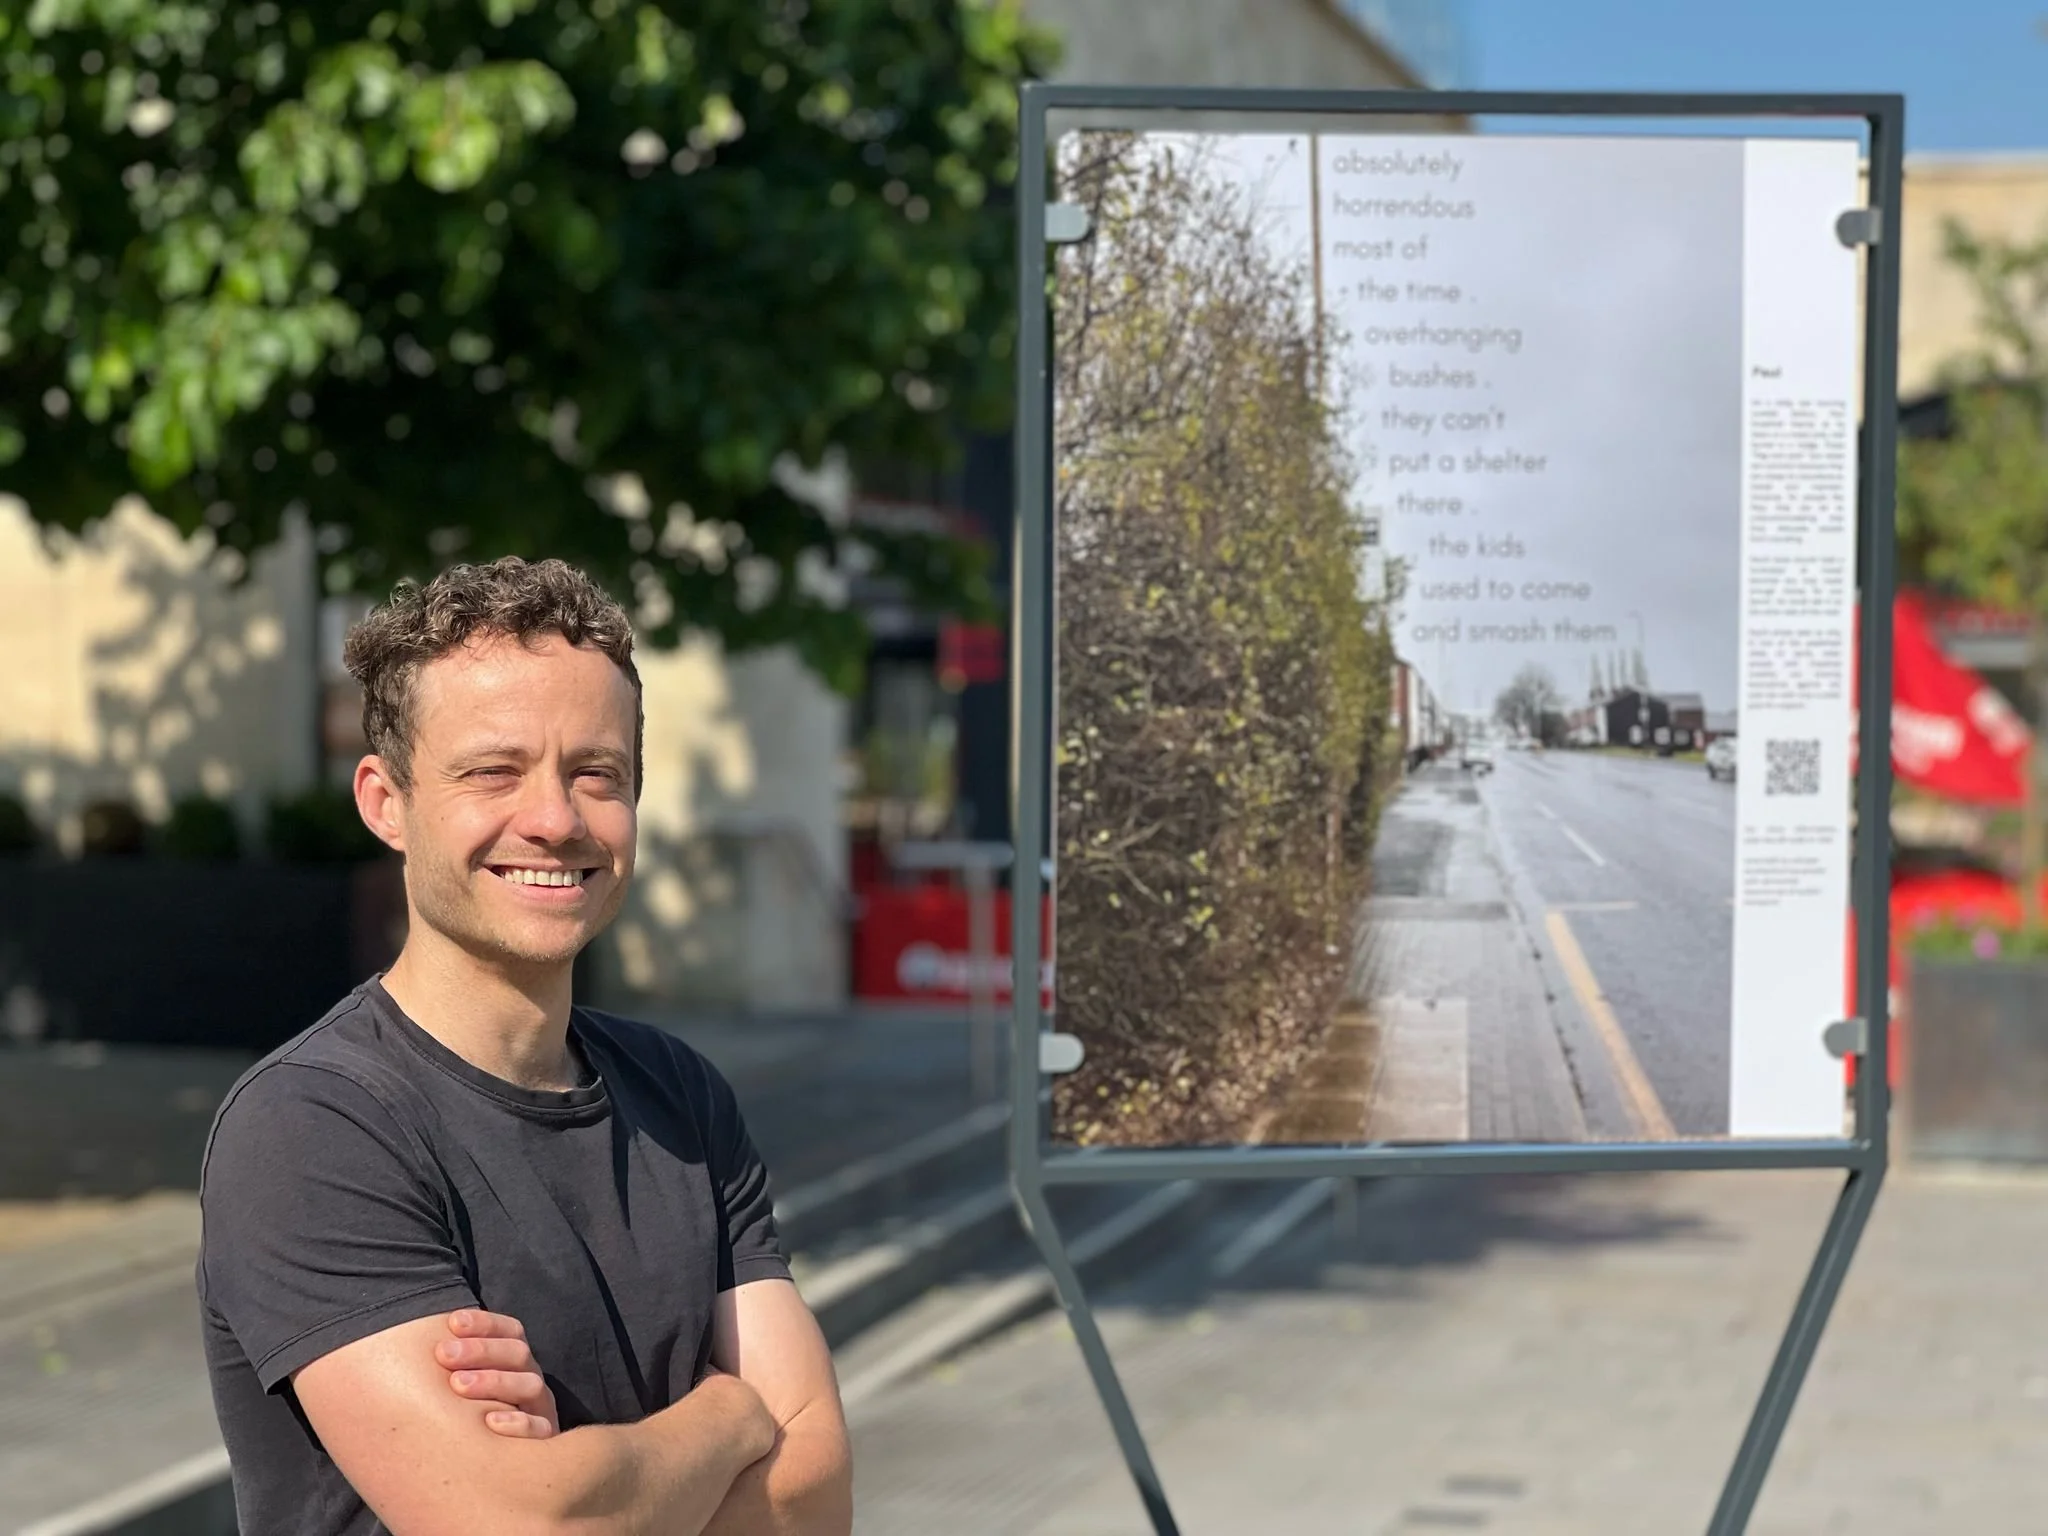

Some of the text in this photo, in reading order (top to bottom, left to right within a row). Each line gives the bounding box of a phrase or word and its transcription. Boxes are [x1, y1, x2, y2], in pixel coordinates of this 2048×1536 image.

[1332, 150, 1464, 183] absolutely
[1333, 192, 1475, 219] horrendous
[1333, 234, 1429, 260] most of
[1357, 278, 1398, 302] the
[1406, 280, 1461, 303] time
[1364, 321, 1522, 354] overhanging
[1389, 363, 1476, 388] bushes
[1381, 405, 1506, 436] they can't
[1389, 447, 1547, 476] put a shelter
[1397, 491, 1463, 515] there
[1429, 532, 1526, 559] the kids
[1419, 576, 1592, 601] used to come
[1411, 617, 1617, 643] and smash them
